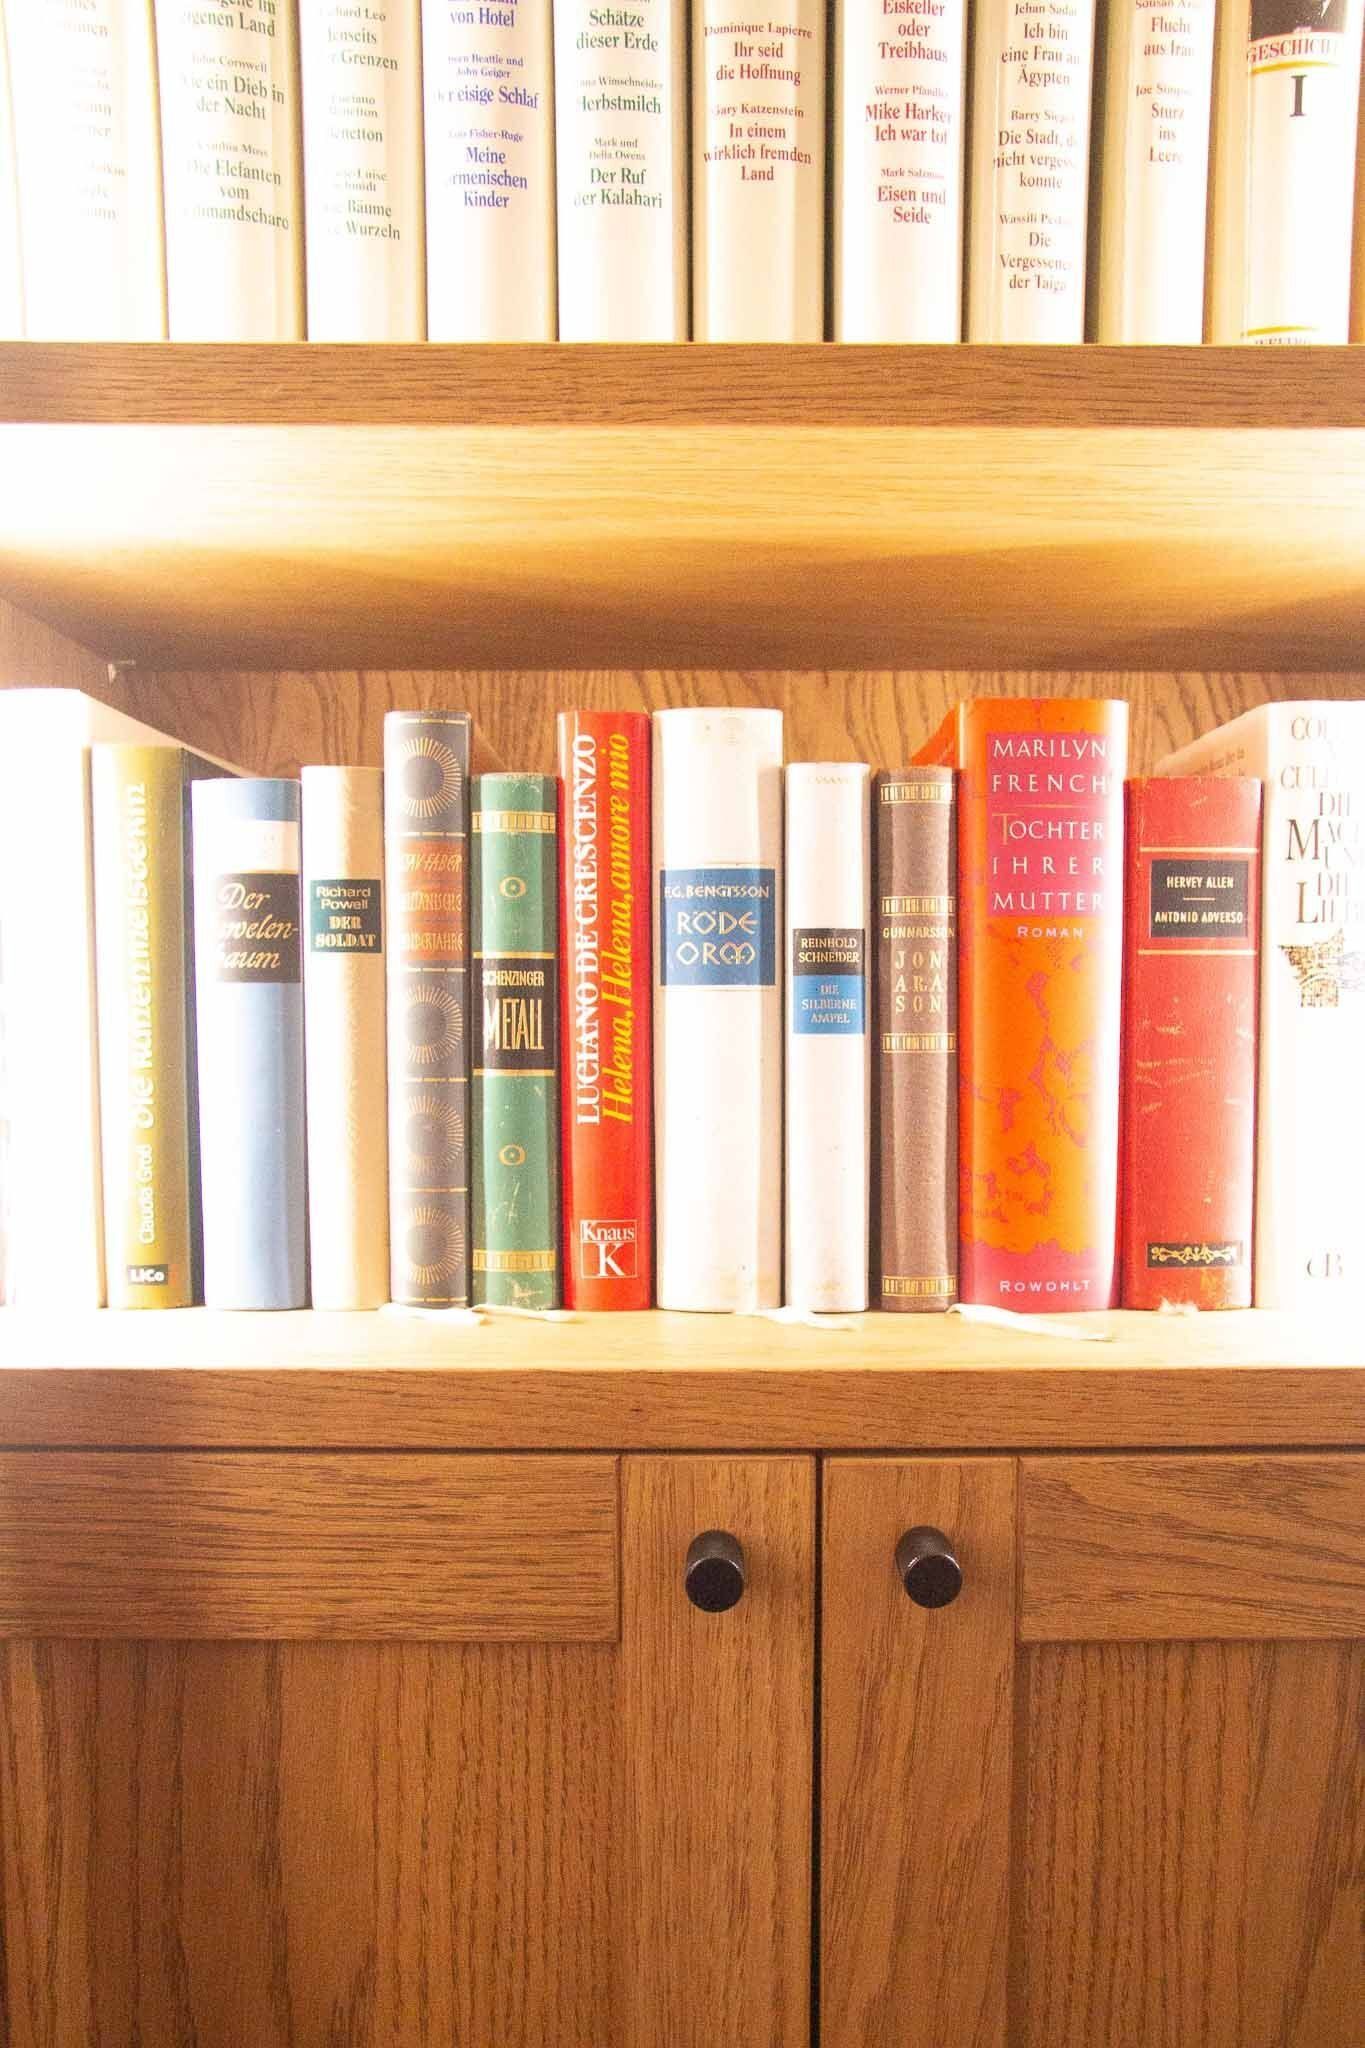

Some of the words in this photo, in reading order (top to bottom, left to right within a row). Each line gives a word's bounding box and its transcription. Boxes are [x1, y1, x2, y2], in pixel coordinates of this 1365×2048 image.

[365, 8, 386, 22] Leo
[882, 0, 946, 16] Eiskeller
[1015, 3, 1045, 15] Jehan
[239, 12, 276, 37] Land
[450, 12, 474, 24] von
[479, 7, 515, 28] Hotel
[588, 8, 645, 28] Schätze
[704, 23, 764, 37] Dominique
[768, 22, 813, 39] Lapierre
[897, 18, 931, 37] oder
[1024, 23, 1043, 39] Ich
[1048, 24, 1069, 41] bin
[576, 33, 620, 50] dieser
[623, 32, 659, 52] Erde
[734, 41, 754, 57] Ihr
[758, 42, 784, 58] seid
[1144, 43, 1165, 56] aus
[341, 49, 399, 71] Grenzen
[878, 41, 948, 62] Treibhaus
[1001, 47, 1029, 63] eine
[1033, 46, 1063, 62] Frau
[219, 55, 267, 73] Cornwell
[506, 56, 524, 67] und
[480, 67, 511, 80] Geiger
[716, 64, 735, 81] die
[739, 63, 801, 86] Hoffnung
[1017, 64, 1071, 87] Ägypten
[207, 74, 228, 92] ein
[233, 75, 268, 99] Dieb
[271, 83, 285, 105] in
[457, 86, 494, 105] eisige
[498, 85, 539, 110] Schlaf
[874, 85, 910, 97] Werner
[1136, 84, 1152, 97] Joe
[1290, 74, 1308, 117] I
[196, 96, 219, 113] der
[224, 96, 266, 120] Nacht
[741, 103, 804, 118] Katzenstein
[865, 102, 900, 121] Mike
[1010, 109, 1040, 123] Barry
[1152, 103, 1184, 118] Sturz
[729, 123, 742, 138] In
[747, 122, 786, 139] einem
[875, 124, 896, 142] Ich
[901, 127, 928, 142] war
[998, 130, 1022, 147] Die
[1159, 126, 1176, 141] ins
[594, 137, 617, 148] Mark
[620, 137, 638, 148] und
[466, 146, 506, 164] Meine
[703, 143, 755, 163] wirklich
[760, 143, 812, 165] fremden
[993, 152, 1025, 170] nicht
[215, 159, 281, 186] Elefanten
[447, 169, 528, 190] rmenischen
[590, 167, 617, 184] Der
[620, 167, 647, 184] Ruf
[741, 165, 774, 181] Land
[881, 168, 905, 178] Mark
[1019, 171, 1063, 189] konnte
[218, 185, 249, 200] vom
[464, 190, 510, 208] Kinder
[600, 188, 663, 208] Kalahari
[877, 186, 917, 203] Eisen
[921, 189, 947, 206] und
[347, 199, 392, 218] Bäume
[893, 206, 931, 225] Seide
[345, 219, 400, 241] Wurzeln
[1029, 232, 1051, 247] Die
[1008, 274, 1031, 289] der
[993, 740, 1107, 760] MARILYN
[600, 733, 630, 790] mio
[993, 774, 1106, 794] FRENCH
[573, 734, 598, 925] CRESCENZO
[992, 813, 1106, 846] TOCHTER
[609, 795, 632, 891] amore
[993, 856, 1106, 875] IHRER
[1167, 876, 1203, 888] HERVEY
[1206, 876, 1235, 888] ALLEN
[217, 883, 270, 910] Der
[316, 887, 371, 897] Richard
[321, 899, 368, 909] Powell
[993, 892, 1106, 911] MUTTER
[329, 916, 361, 929] DER
[677, 911, 759, 934] RÖDE
[1155, 912, 1198, 923] ANTONIO
[1201, 912, 1244, 923] ADVERSO
[315, 933, 376, 948] SOLDAT
[1017, 926, 1084, 938] ROMAN
[574, 931, 599, 974] DE
[601, 893, 634, 1008] Helena,
[801, 938, 857, 949] REINHOLD
[798, 952, 860, 963] SCHNEIDER
[483, 971, 545, 986] SCHENZINGER
[820, 984, 839, 995] DIE
[801, 999, 857, 1010] SILBERNE
[483, 998, 545, 1050] METALL
[811, 1013, 850, 1024] AMPEL
[575, 981, 600, 1125] LUCIANO
[601, 1009, 634, 1124] Helena,
[583, 1222, 635, 1241] Knaus
[597, 1242, 625, 1277] K
[999, 1280, 1092, 1293] ROWOHLT
